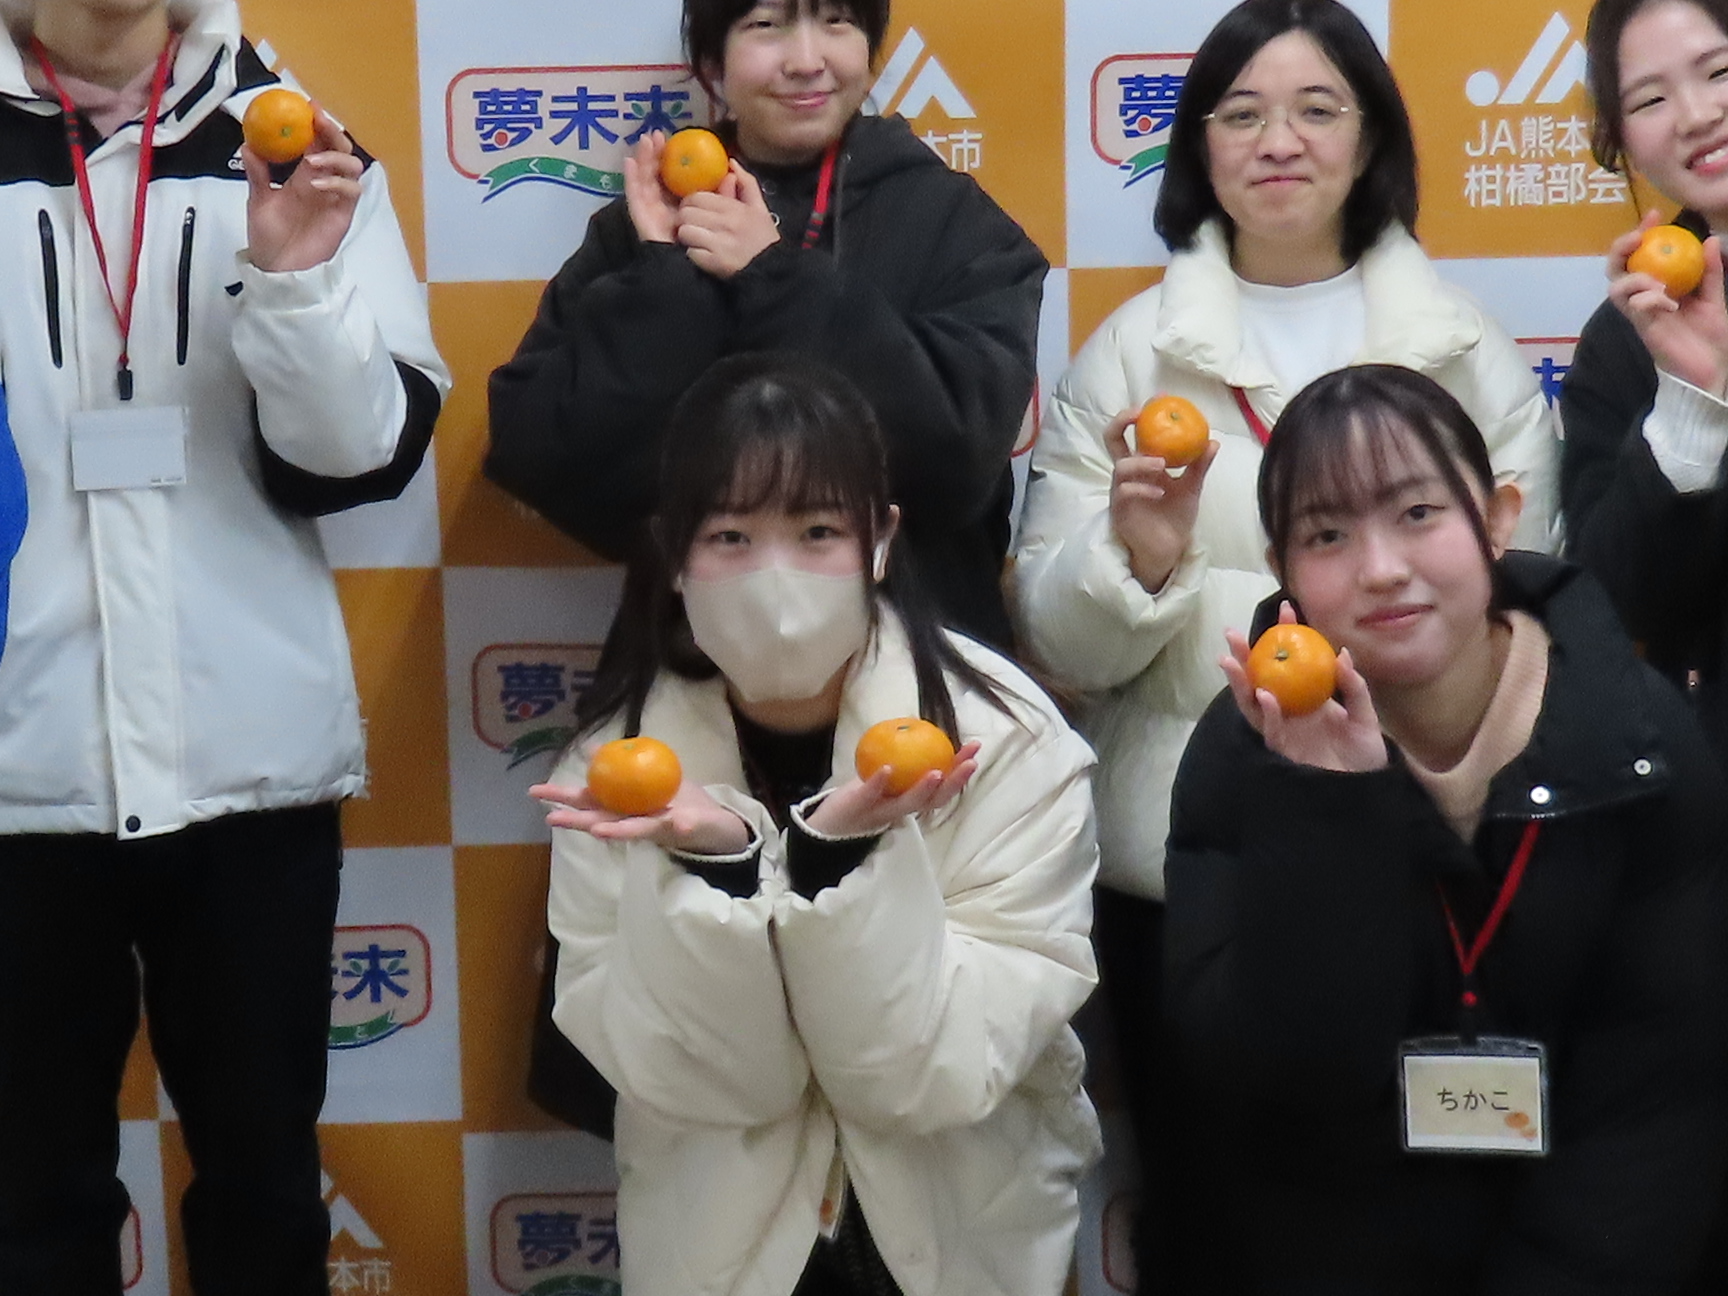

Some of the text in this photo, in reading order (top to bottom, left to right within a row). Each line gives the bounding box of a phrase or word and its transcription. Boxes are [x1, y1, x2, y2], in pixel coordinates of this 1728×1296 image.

[473, 85, 692, 153] 夢未来
[1465, 115, 1591, 158] JA熊本
[1464, 163, 1627, 207] 柑橘部会
[1437, 1086, 1510, 1111] ちかこ
